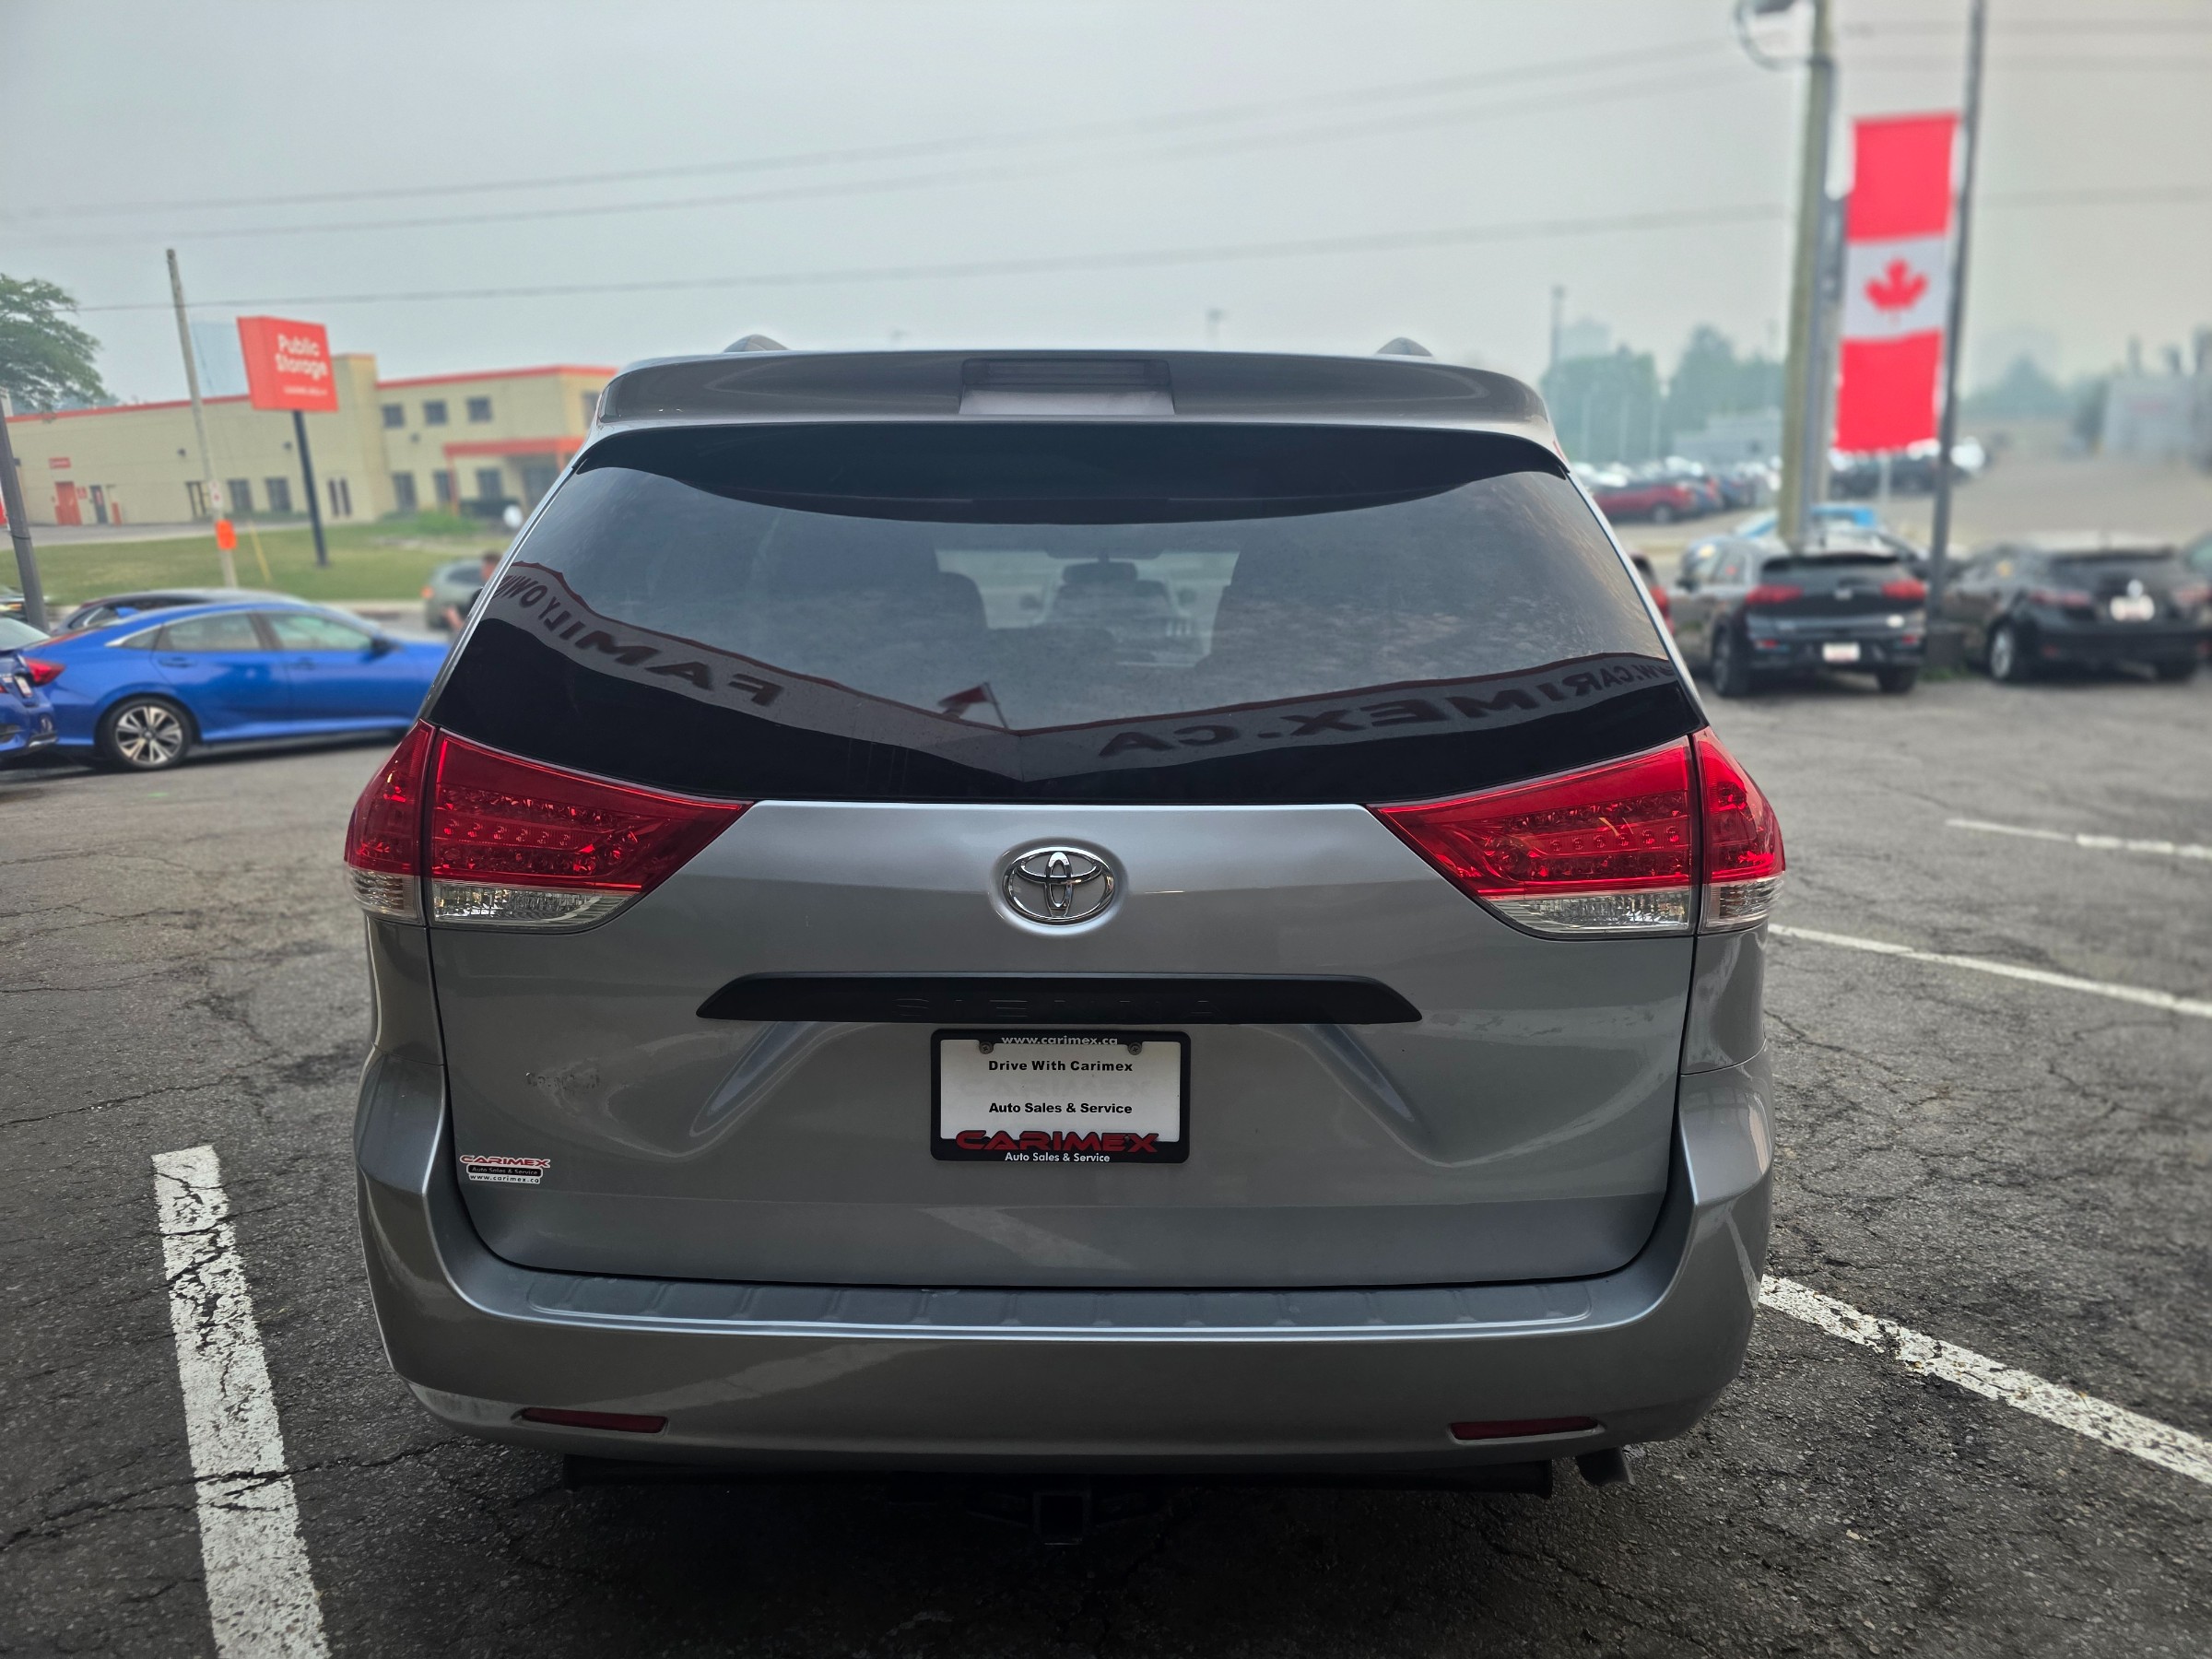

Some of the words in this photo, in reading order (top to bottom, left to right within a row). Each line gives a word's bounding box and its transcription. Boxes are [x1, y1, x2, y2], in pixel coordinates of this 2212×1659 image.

[277, 334, 320, 357] Public
[275, 353, 327, 381] Storage
[1001, 1035, 1118, 1046] www.carimex.ca
[988, 1060, 1028, 1071] Drive
[1031, 1060, 1066, 1071] With
[1070, 1060, 1133, 1072] Carimex
[989, 1102, 1021, 1113] Auto
[1024, 1102, 1062, 1113] Sales
[1065, 1103, 1077, 1113] &
[1080, 1102, 1133, 1114] Service
[955, 1130, 1159, 1152] CARIMEX
[460, 1155, 550, 1168] CARIMEX
[1005, 1152, 1030, 1162] Auto
[1032, 1152, 1060, 1162] Sales
[1062, 1153, 1070, 1162] &
[1073, 1152, 1111, 1163] Service
[469, 1174, 540, 1183] www.carimex.ca
